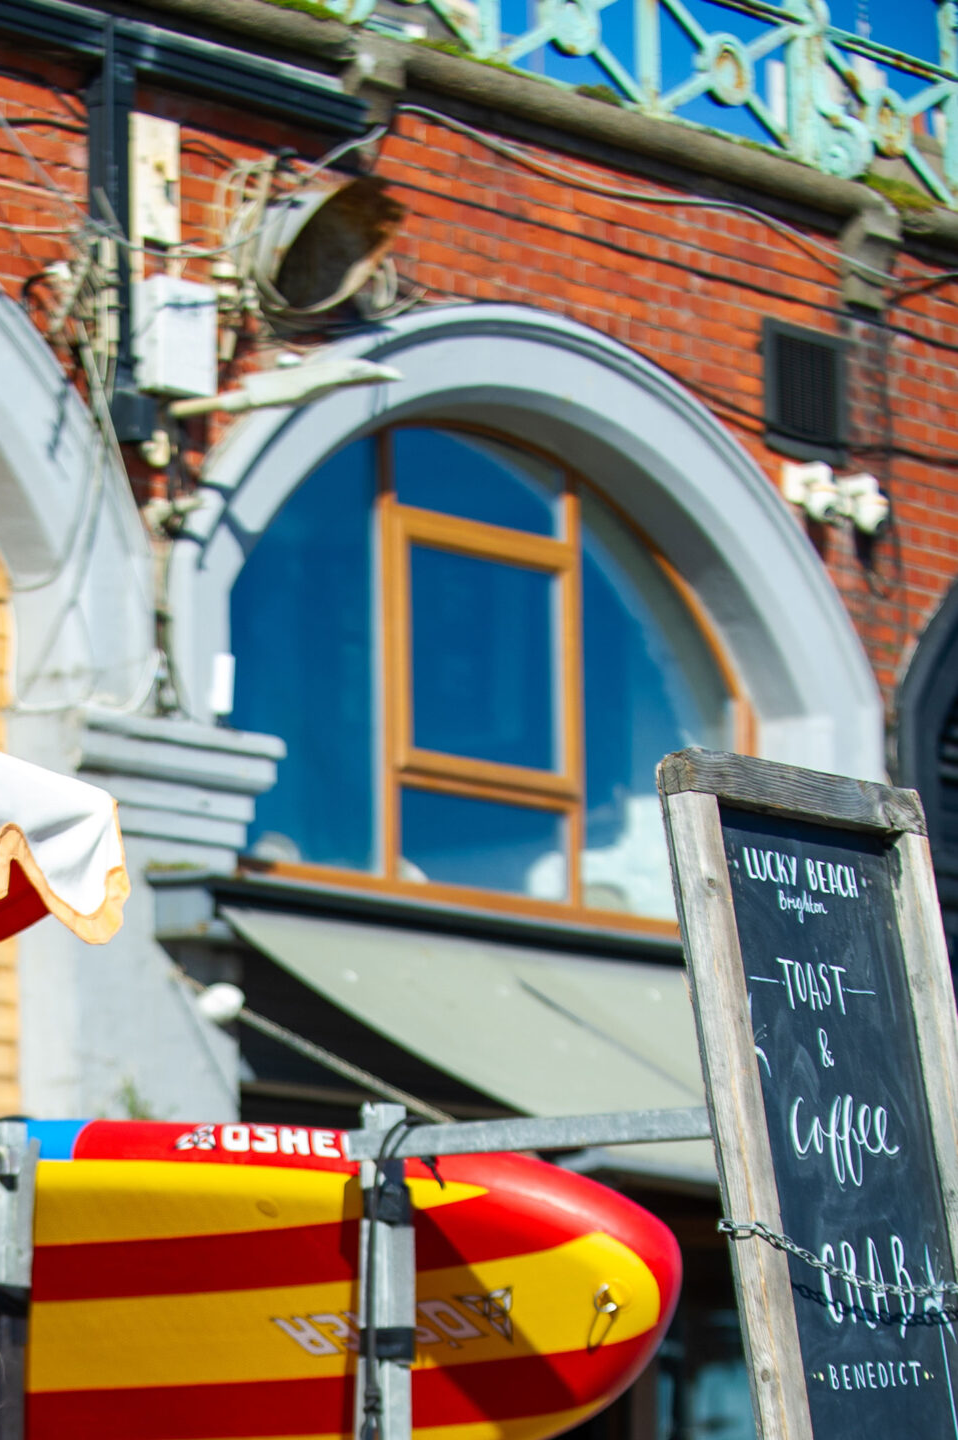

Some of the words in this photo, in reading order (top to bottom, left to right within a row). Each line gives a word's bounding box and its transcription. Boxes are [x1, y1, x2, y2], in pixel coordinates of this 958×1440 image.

[742, 847, 797, 886] LUCKY
[805, 858, 859, 898] BEACH
[778, 890, 828, 924] Brighton
[776, 957, 846, 1015] TOAST
[817, 1027, 835, 1068] &
[222, 1124, 350, 1159] OSHE
[790, 1094, 900, 1188] Coffee
[822, 1235, 916, 1339] CRAB
[828, 1360, 921, 1390] BENEDICT
